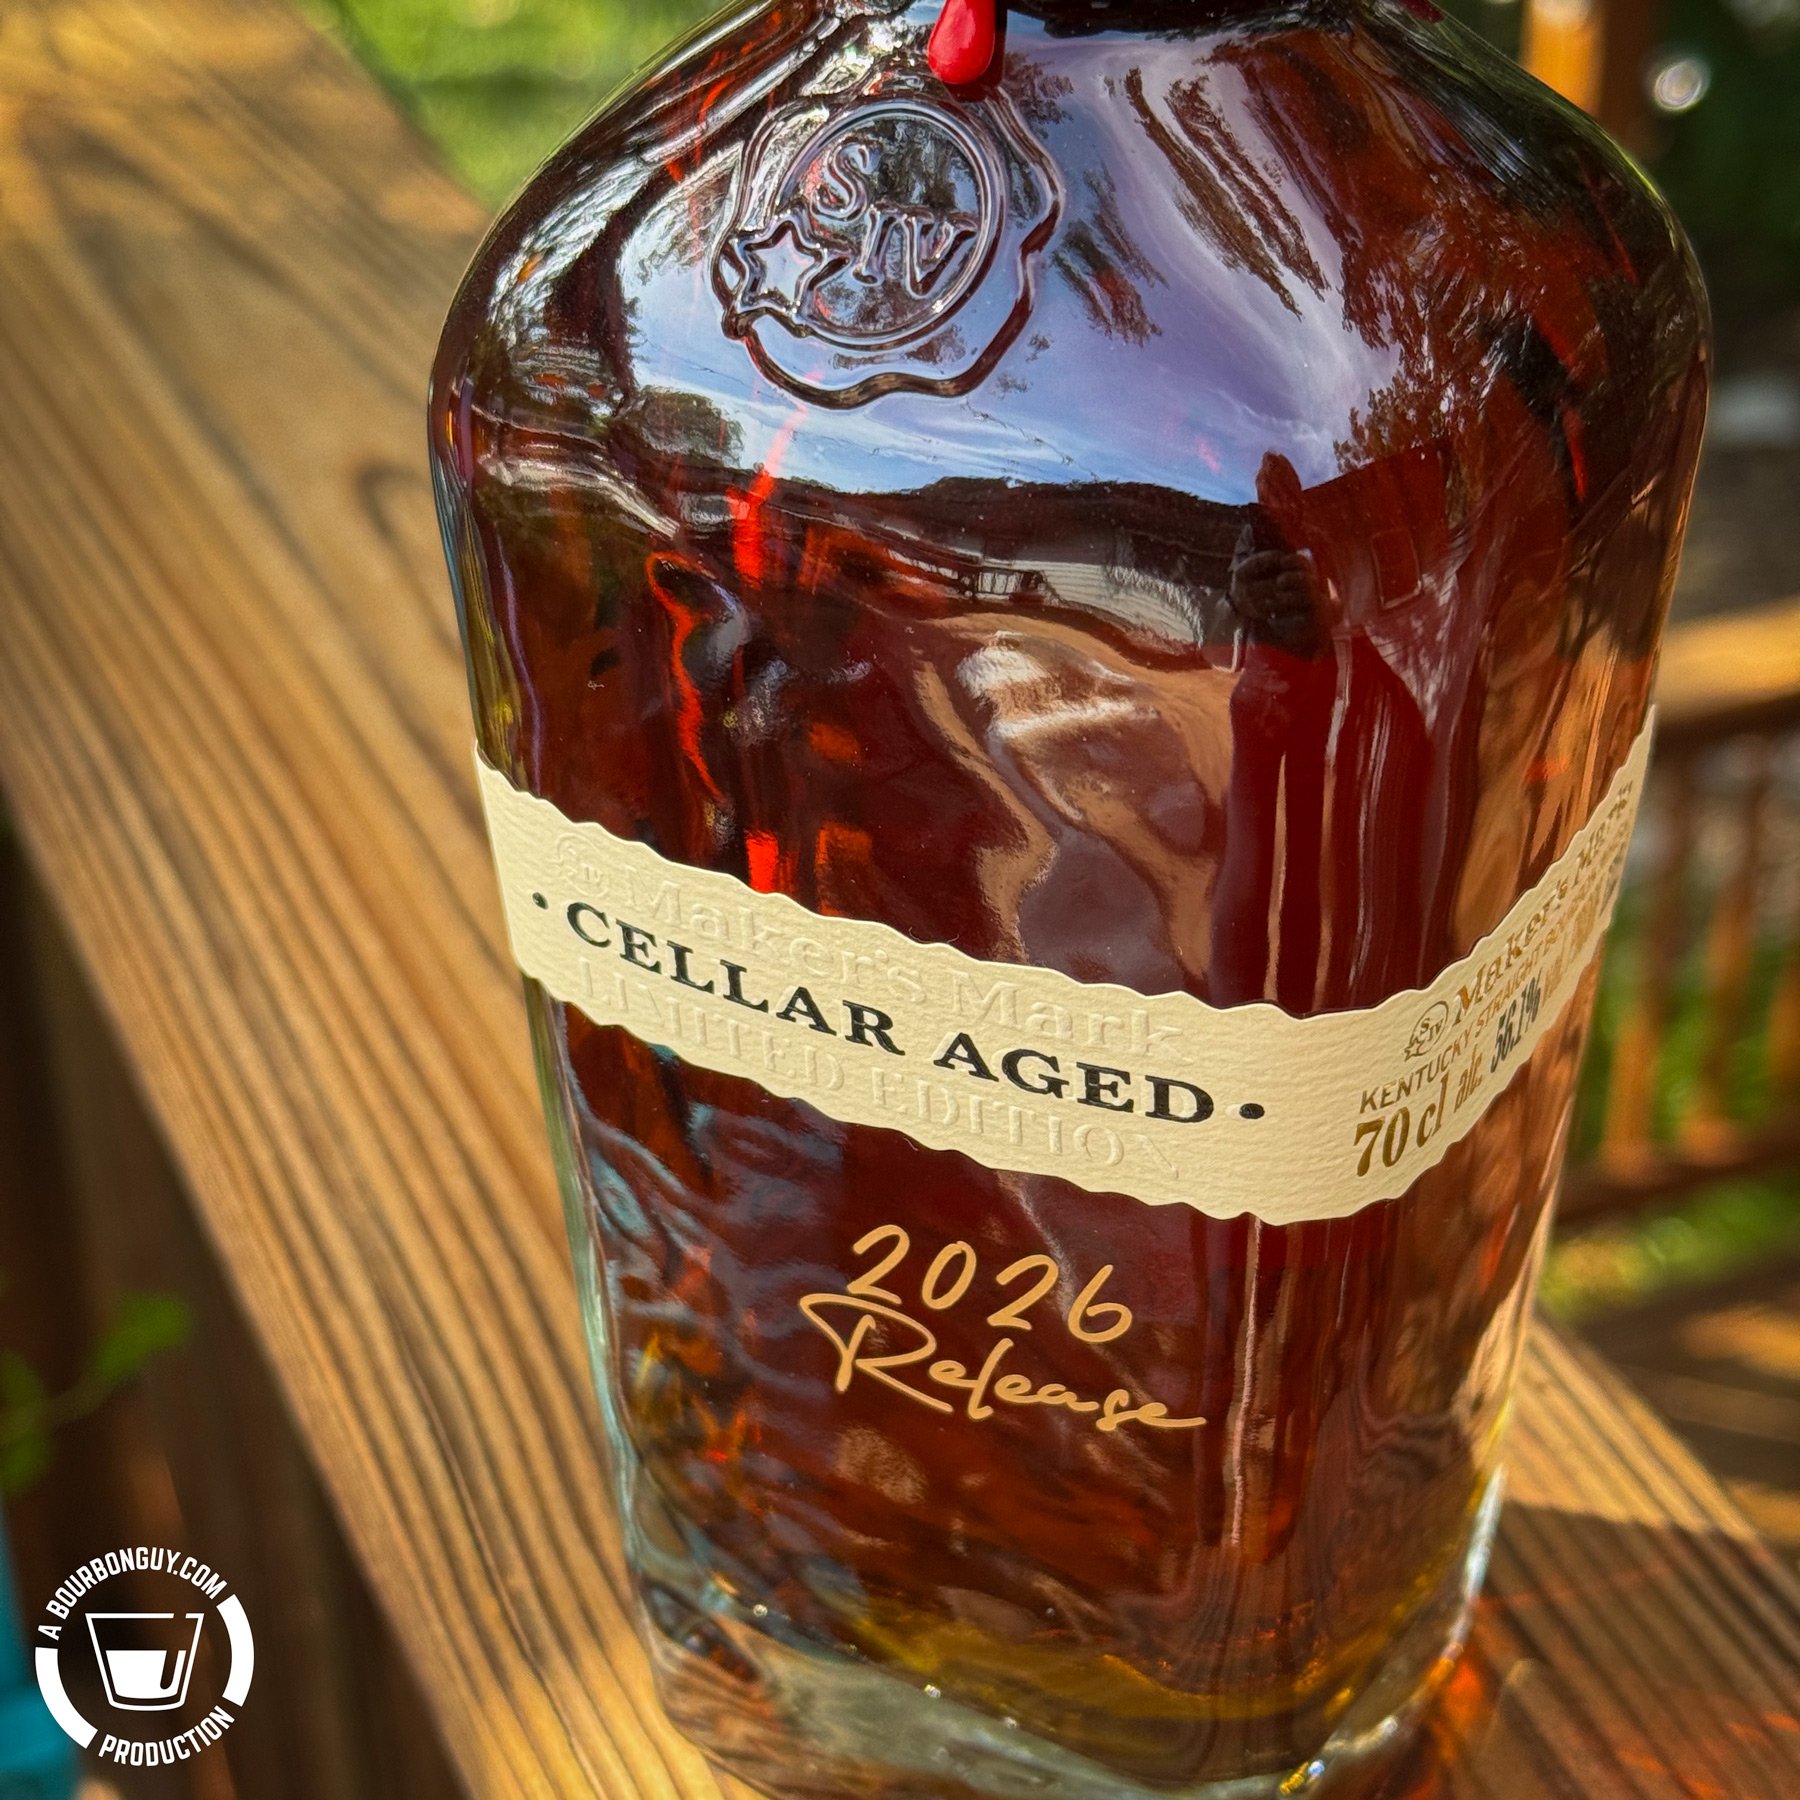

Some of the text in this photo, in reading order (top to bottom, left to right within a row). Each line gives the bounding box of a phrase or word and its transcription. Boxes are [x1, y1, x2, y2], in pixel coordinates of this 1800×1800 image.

[567, 902, 1213, 1122] CELLAR AGED
[624, 865, 926, 1003] Maker's
[950, 970, 1194, 1063] Mark
[1360, 1022, 1474, 1114] KENTUCKY
[1475, 940, 1543, 1038] STRAIGHT
[1354, 1107, 1410, 1177] 70
[1416, 1072, 1449, 1148] cl
[847, 1224, 1132, 1342] 2026
[799, 1293, 1207, 1430] Release
